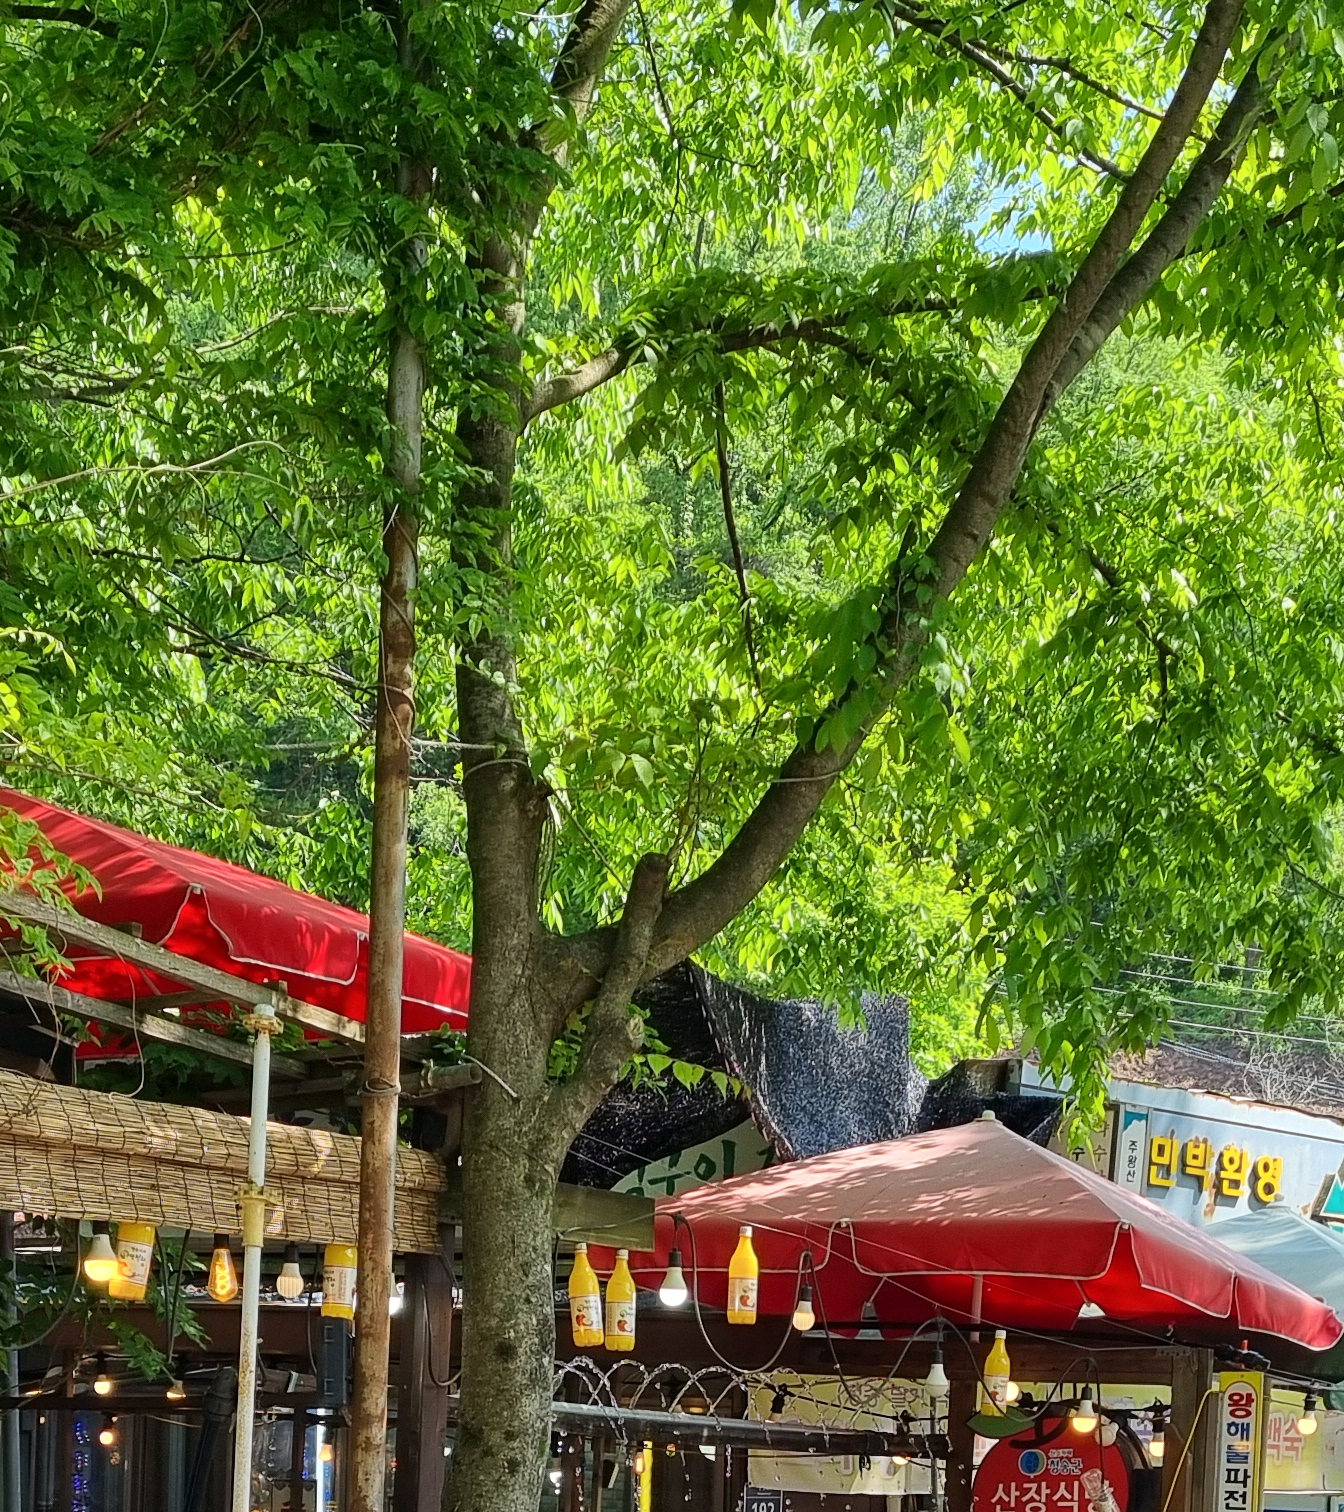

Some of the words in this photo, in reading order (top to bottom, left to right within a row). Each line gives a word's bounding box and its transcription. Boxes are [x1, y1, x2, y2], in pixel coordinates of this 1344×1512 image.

[1126, 1140, 1139, 1183] 주왕산
[1149, 1135, 1284, 1203] 민박환영
[1049, 1458, 1082, 1475] 청송군
[1223, 1391, 1255, 1511] 왕해물파전
